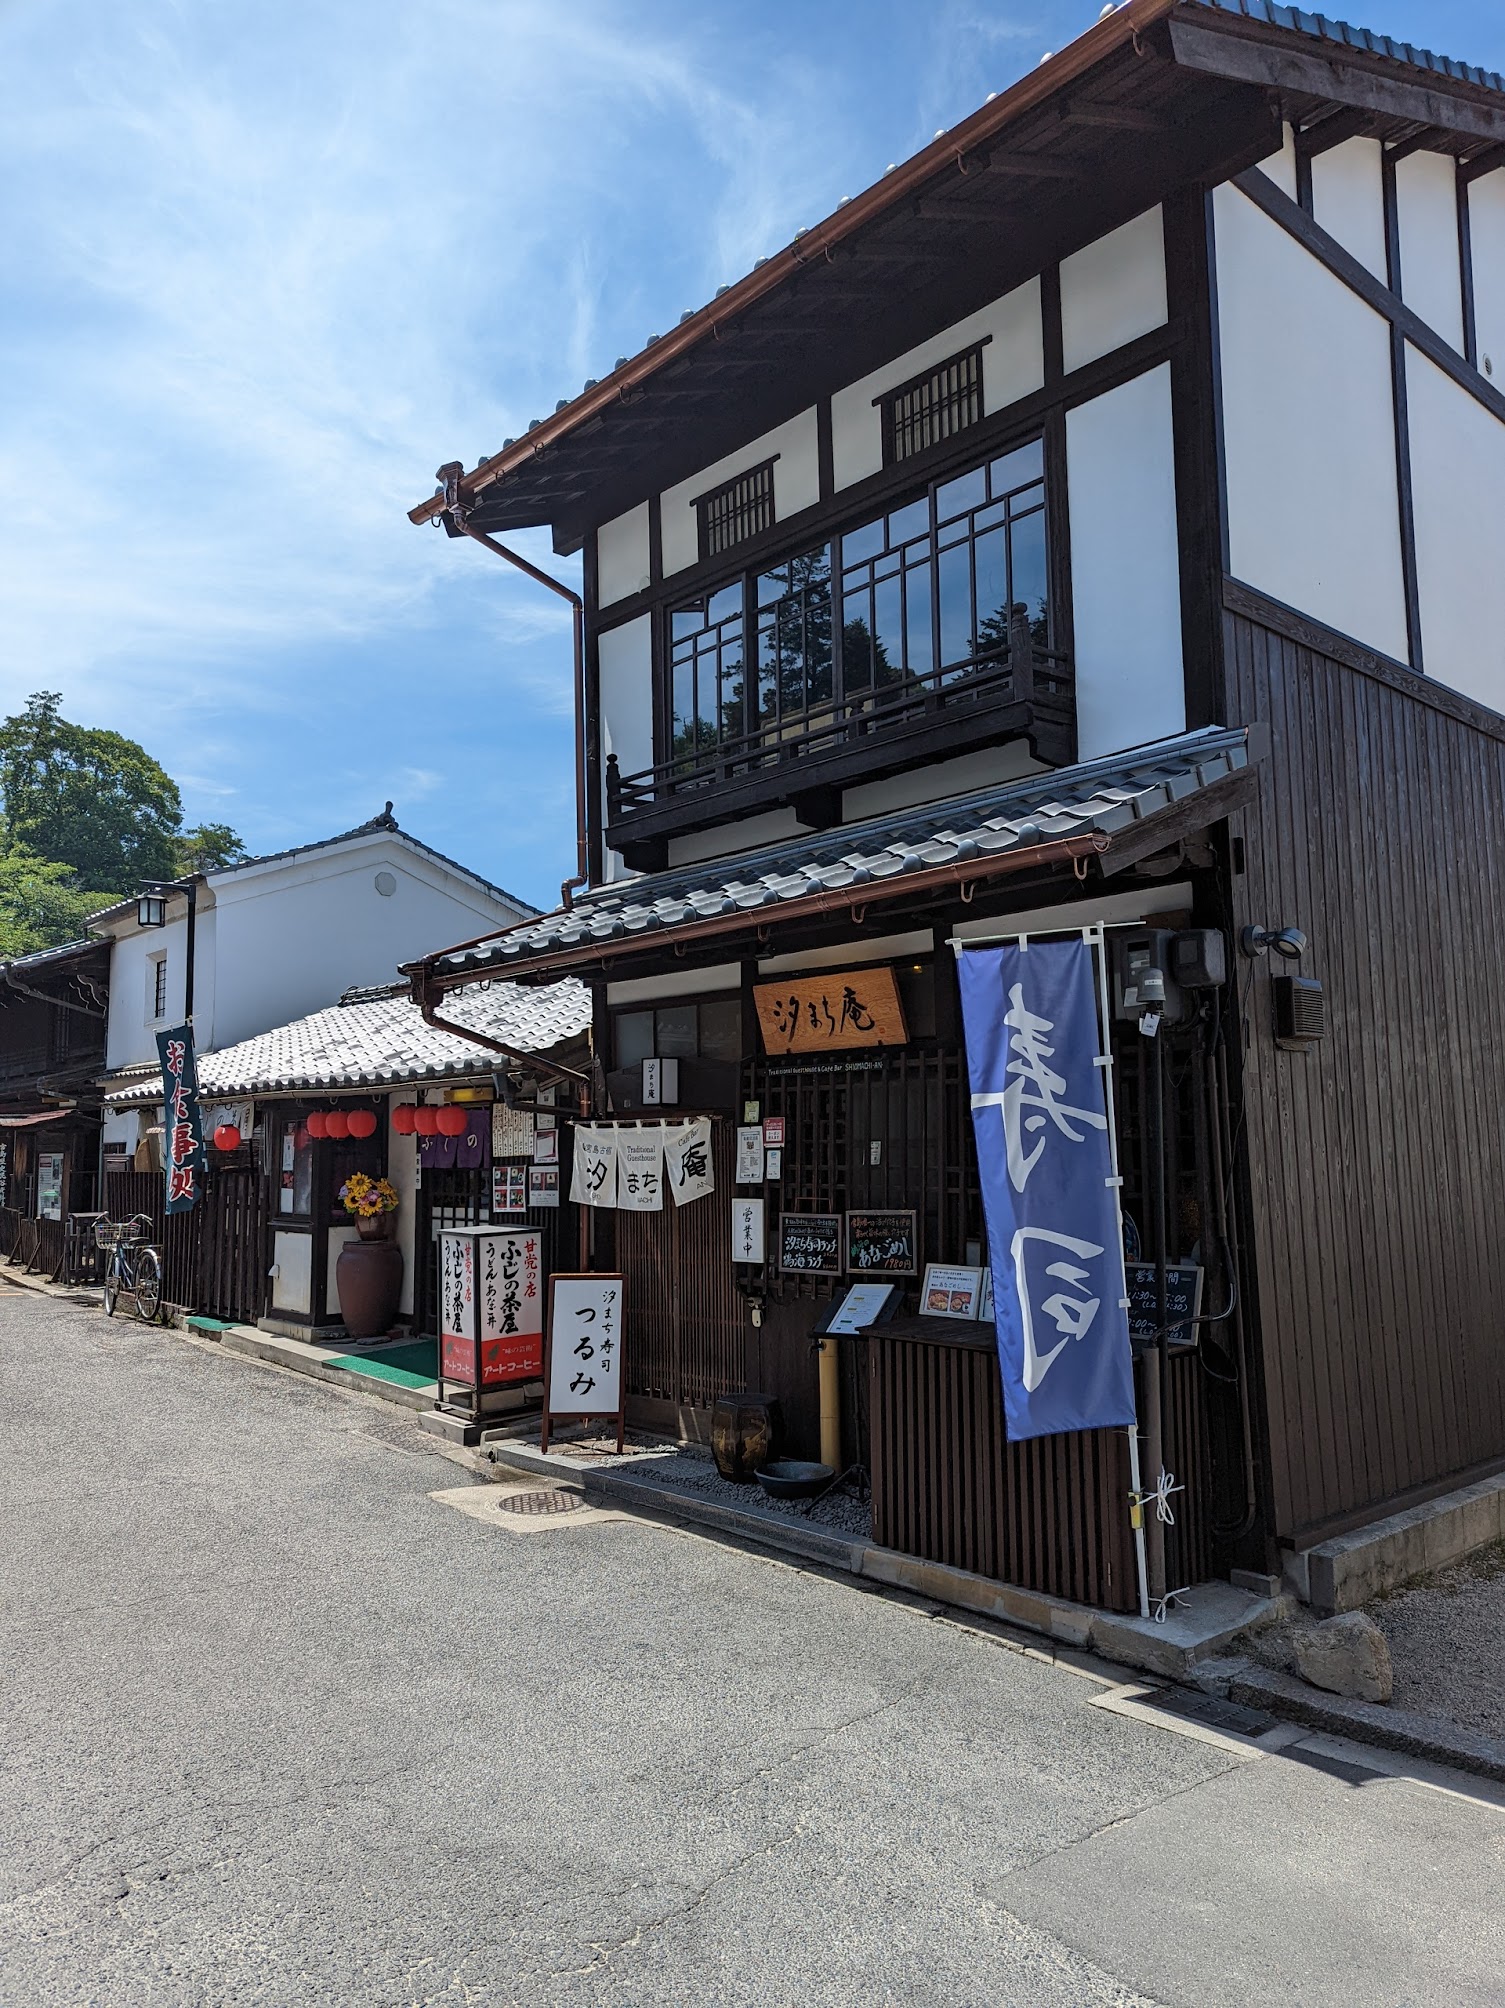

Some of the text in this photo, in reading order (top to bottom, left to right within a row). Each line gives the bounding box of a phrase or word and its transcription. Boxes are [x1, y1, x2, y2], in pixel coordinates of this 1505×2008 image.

[773, 986, 875, 1043] 汐まち庵
[647, 1063, 656, 1099] 汐まち庵
[586, 1158, 608, 1191] 汐
[627, 1170, 659, 1194] まち
[679, 1140, 708, 1187] 庵
[627, 1145, 656, 1153] Traditional
[627, 1154, 656, 1162] Guesthouse
[742, 1206, 753, 1257] 営業中
[859, 1236, 912, 1267] あなごめし
[452, 1240, 464, 1333] ふじの茶屋
[500, 1240, 522, 1334] ふじの茶屋
[523, 1238, 538, 1298] 甘党の店
[884, 1258, 911, 1268] 1980円
[569, 1307, 597, 1396] つるみ
[600, 1289, 617, 1373] 汐まち寿司
[443, 1359, 475, 1375] アートコーヒー
[484, 1359, 541, 1377] アートコーヒー
